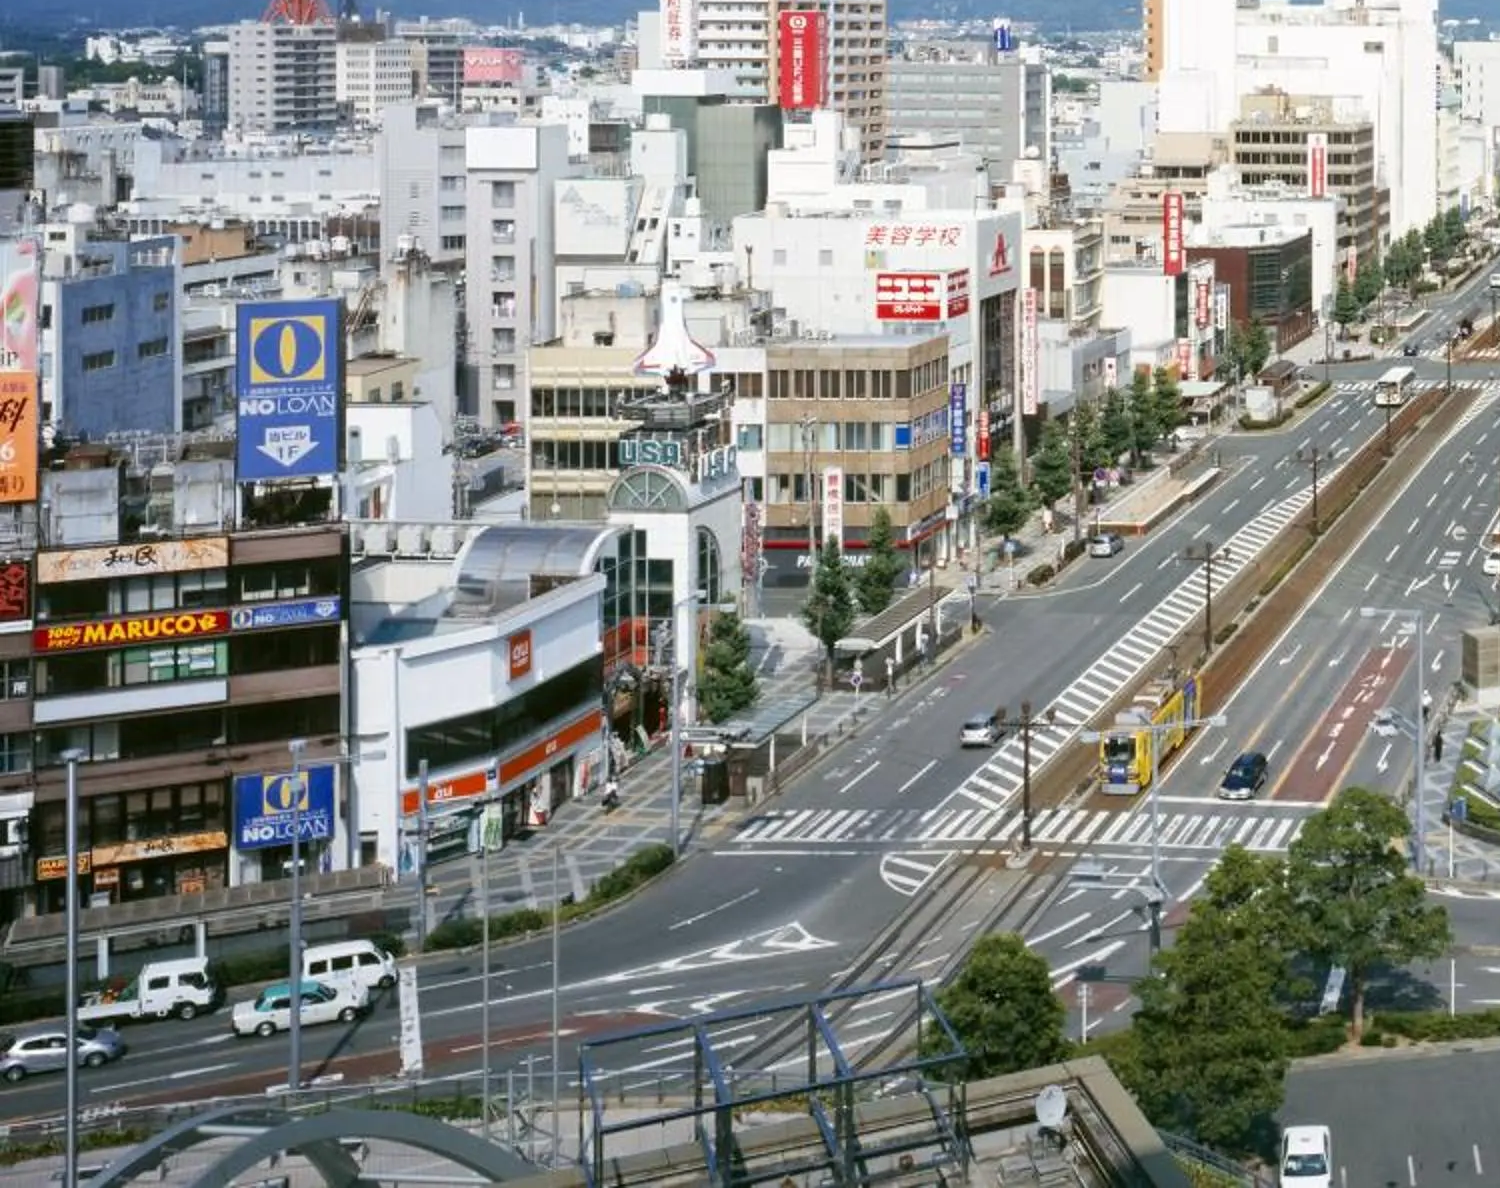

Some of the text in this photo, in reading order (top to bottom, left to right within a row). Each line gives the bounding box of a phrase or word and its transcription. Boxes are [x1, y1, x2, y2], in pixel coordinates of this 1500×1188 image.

[865, 224, 961, 247] 美容学校
[239, 394, 335, 416] NO LOAN
[279, 445, 300, 460] 1F
[619, 439, 681, 465] USA
[83, 614, 197, 644] MARUCO
[510, 640, 529, 660] au
[433, 783, 453, 800] au
[242, 825, 275, 844] NO
